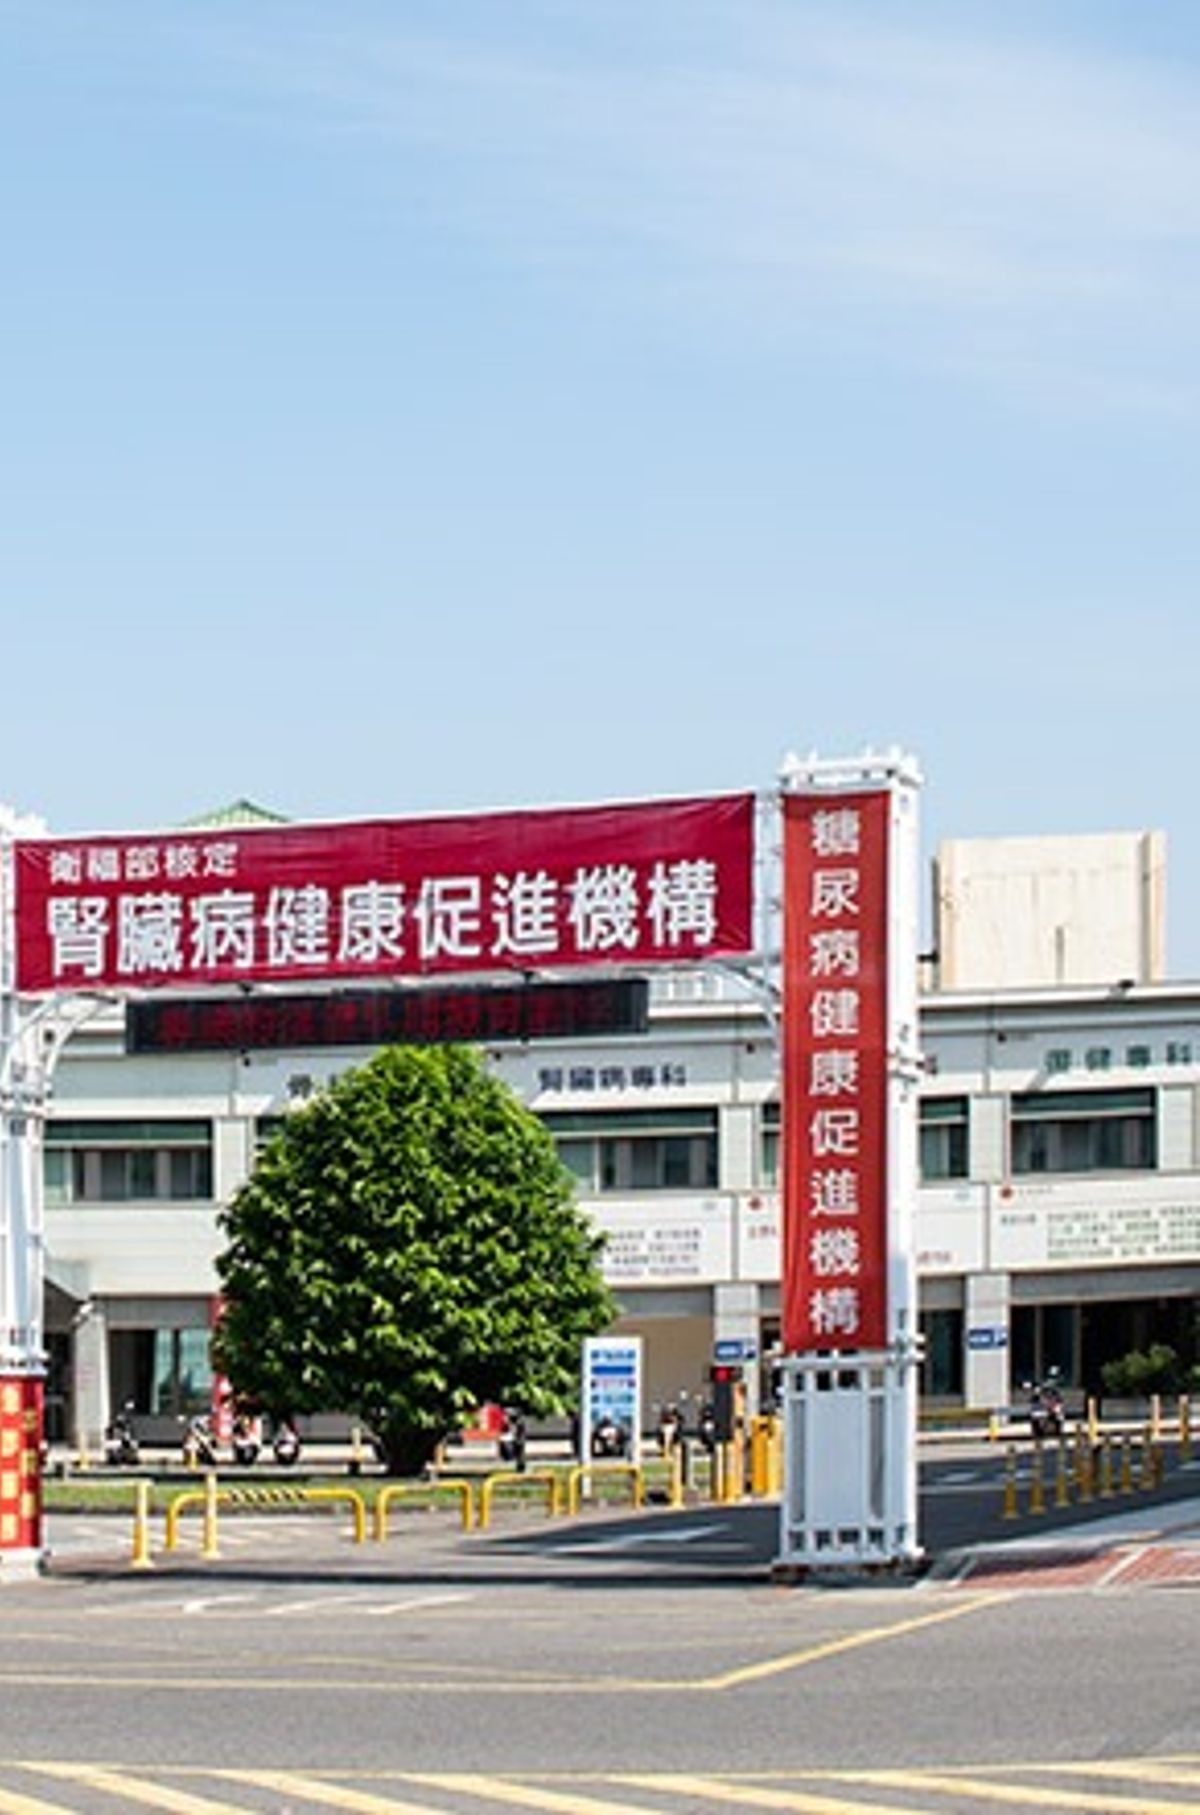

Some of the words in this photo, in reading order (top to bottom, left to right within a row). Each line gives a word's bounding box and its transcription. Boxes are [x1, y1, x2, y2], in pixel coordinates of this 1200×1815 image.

[47, 859, 719, 977] 腎臟病健康促進機構
[809, 809, 861, 1335] 糖尿病健康促進機構
